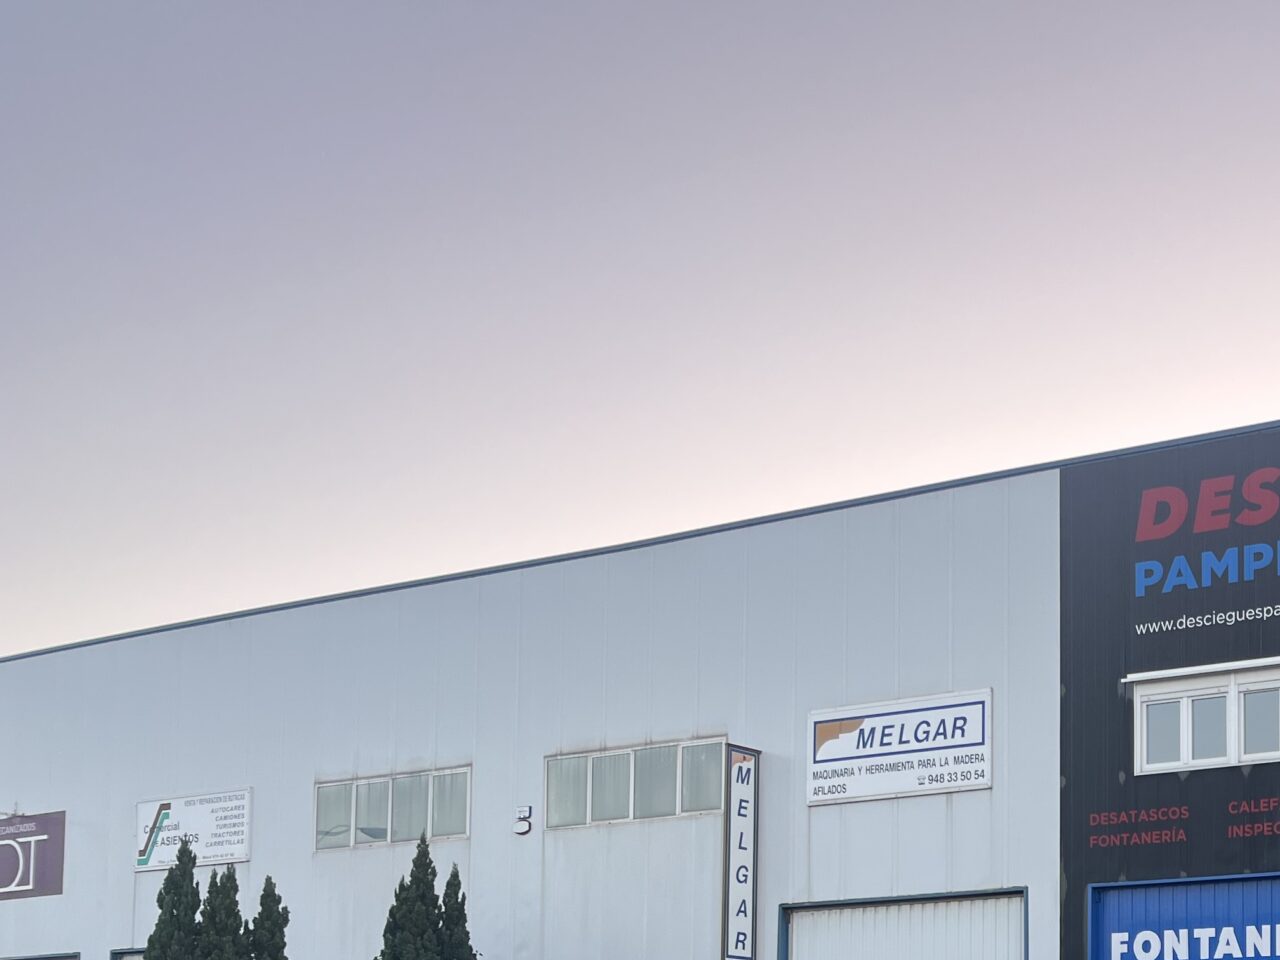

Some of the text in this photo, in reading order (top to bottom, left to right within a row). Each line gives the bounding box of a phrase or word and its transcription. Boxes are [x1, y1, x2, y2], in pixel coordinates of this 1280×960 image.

[856, 716, 968, 750] MELGAR
[812, 753, 985, 781] MAQUINARIA Y HERRAMIENTA PARA LA MADERA
[927, 769, 985, 785] 948 33 50 54
[812, 784, 847, 797] AFILADOS
[1089, 805, 1189, 827] DESATASCOS
[1089, 828, 1188, 849] FONTANERÍA
[735, 765, 751, 951] MELGAR
